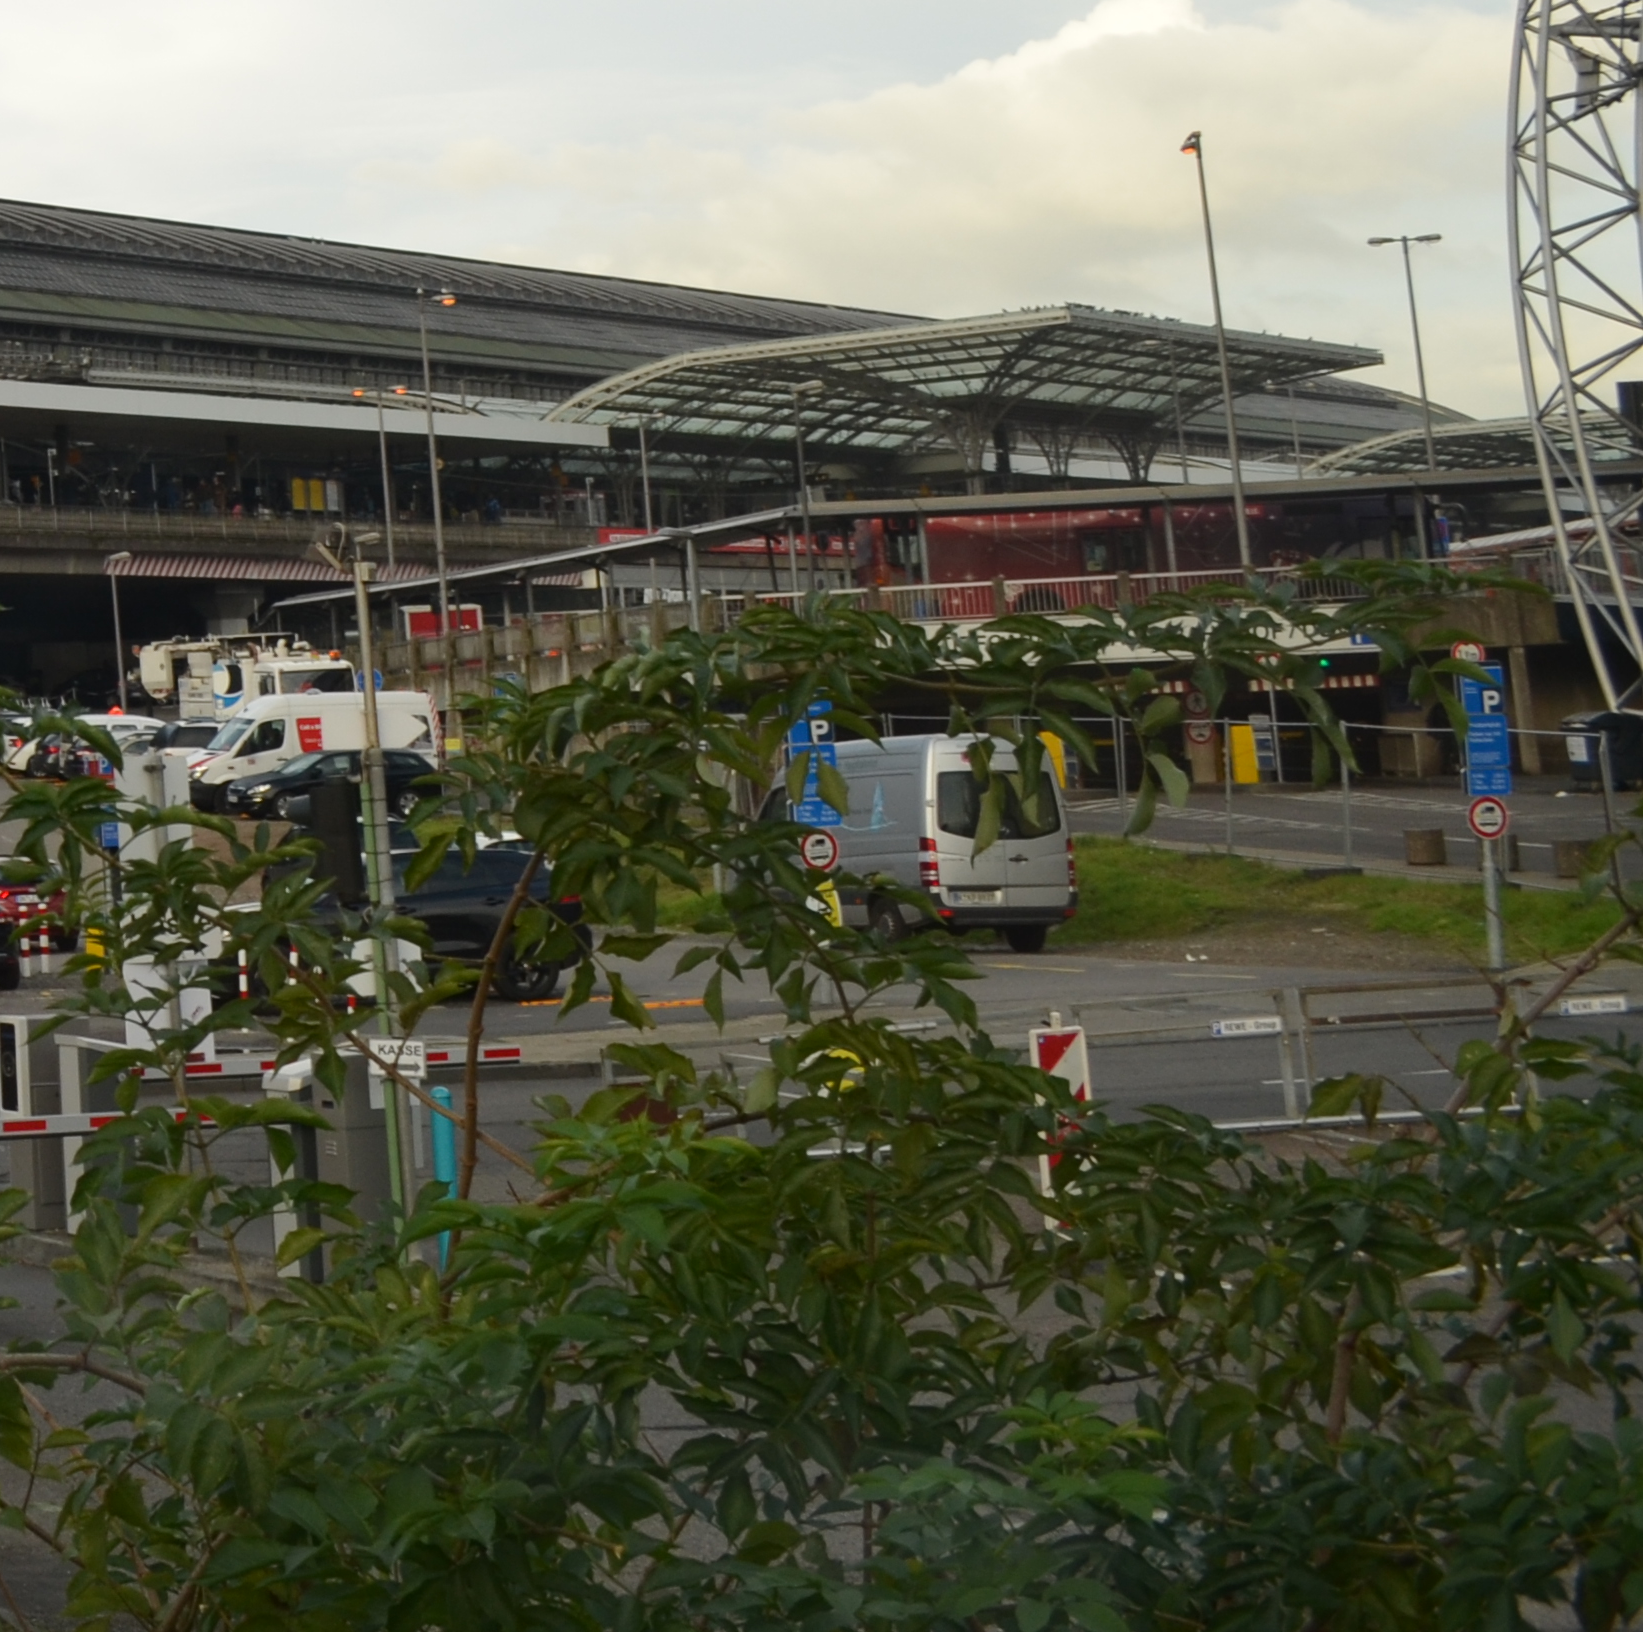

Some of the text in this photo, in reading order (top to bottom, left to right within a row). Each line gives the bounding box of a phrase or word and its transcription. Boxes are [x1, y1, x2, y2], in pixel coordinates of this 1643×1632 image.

[1482, 689, 1500, 714] P
[810, 719, 828, 744] P
[1213, 1022, 1220, 1034] P
[1223, 1022, 1248, 1032] REWE
[1254, 1020, 1277, 1032] Group
[377, 1044, 422, 1056] KASSE
